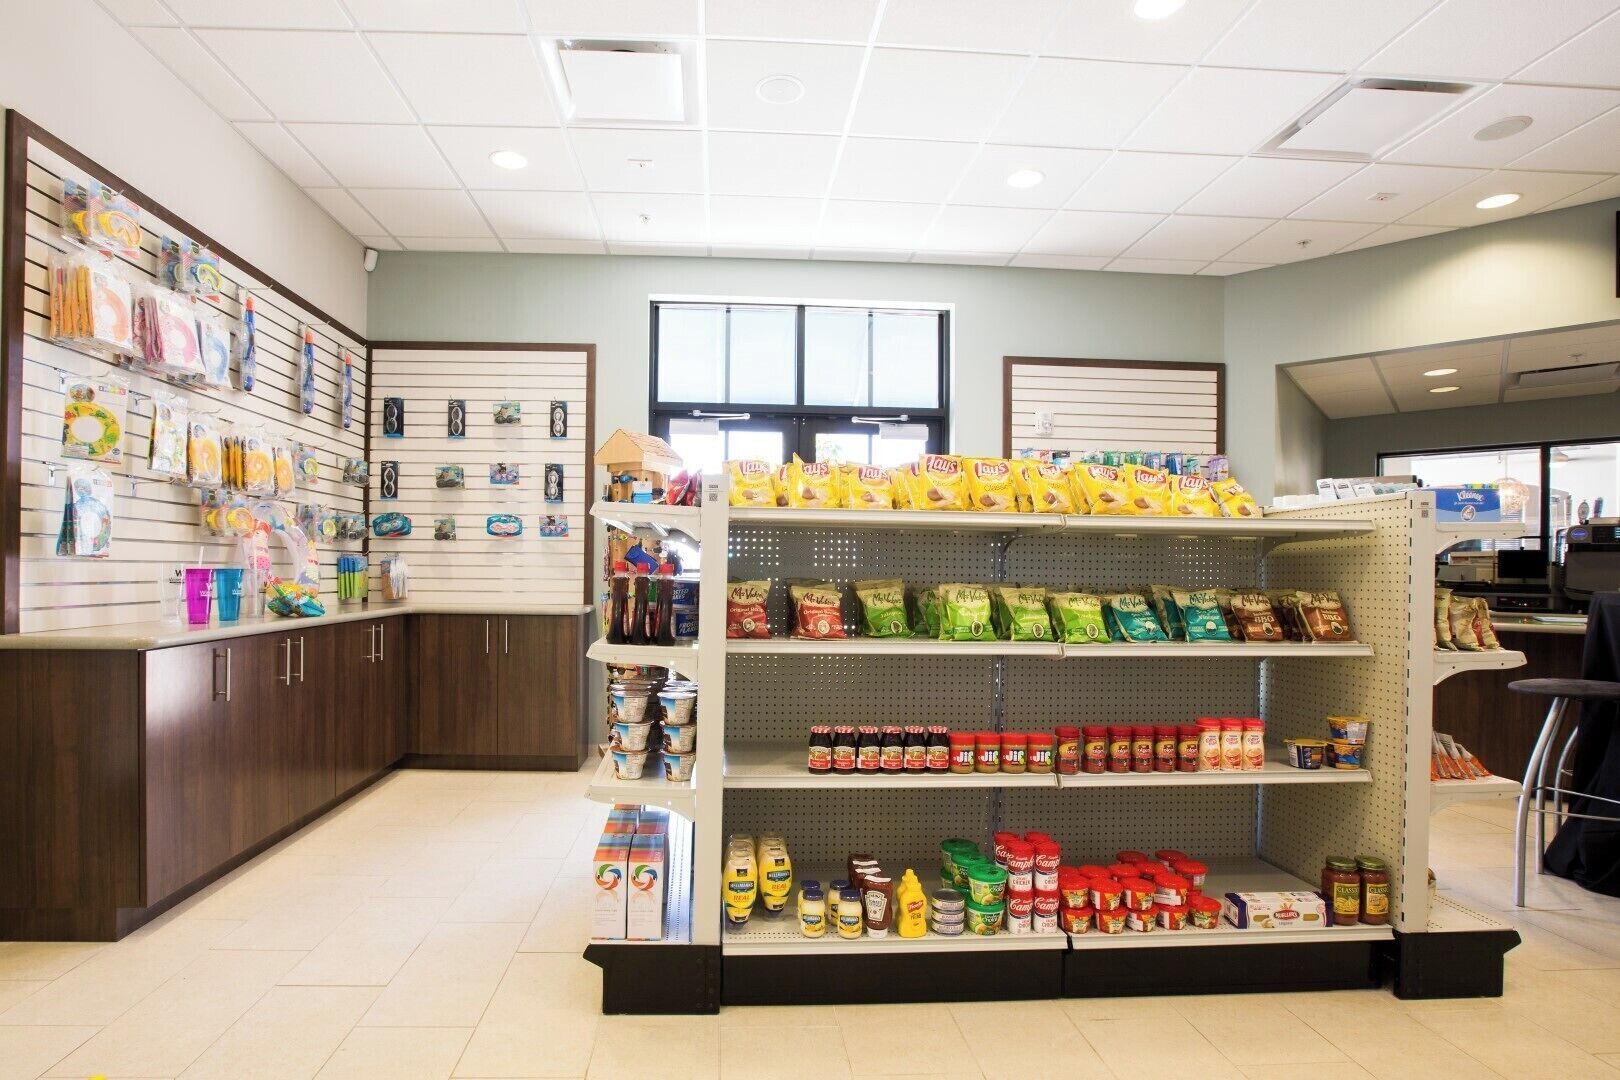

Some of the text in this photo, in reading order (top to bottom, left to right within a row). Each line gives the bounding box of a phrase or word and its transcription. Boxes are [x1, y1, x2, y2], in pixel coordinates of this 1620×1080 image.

[957, 751, 974, 763] Jif
[981, 751, 998, 762] Jif
[1005, 751, 1024, 762] Jif
[1033, 751, 1050, 763] Jif
